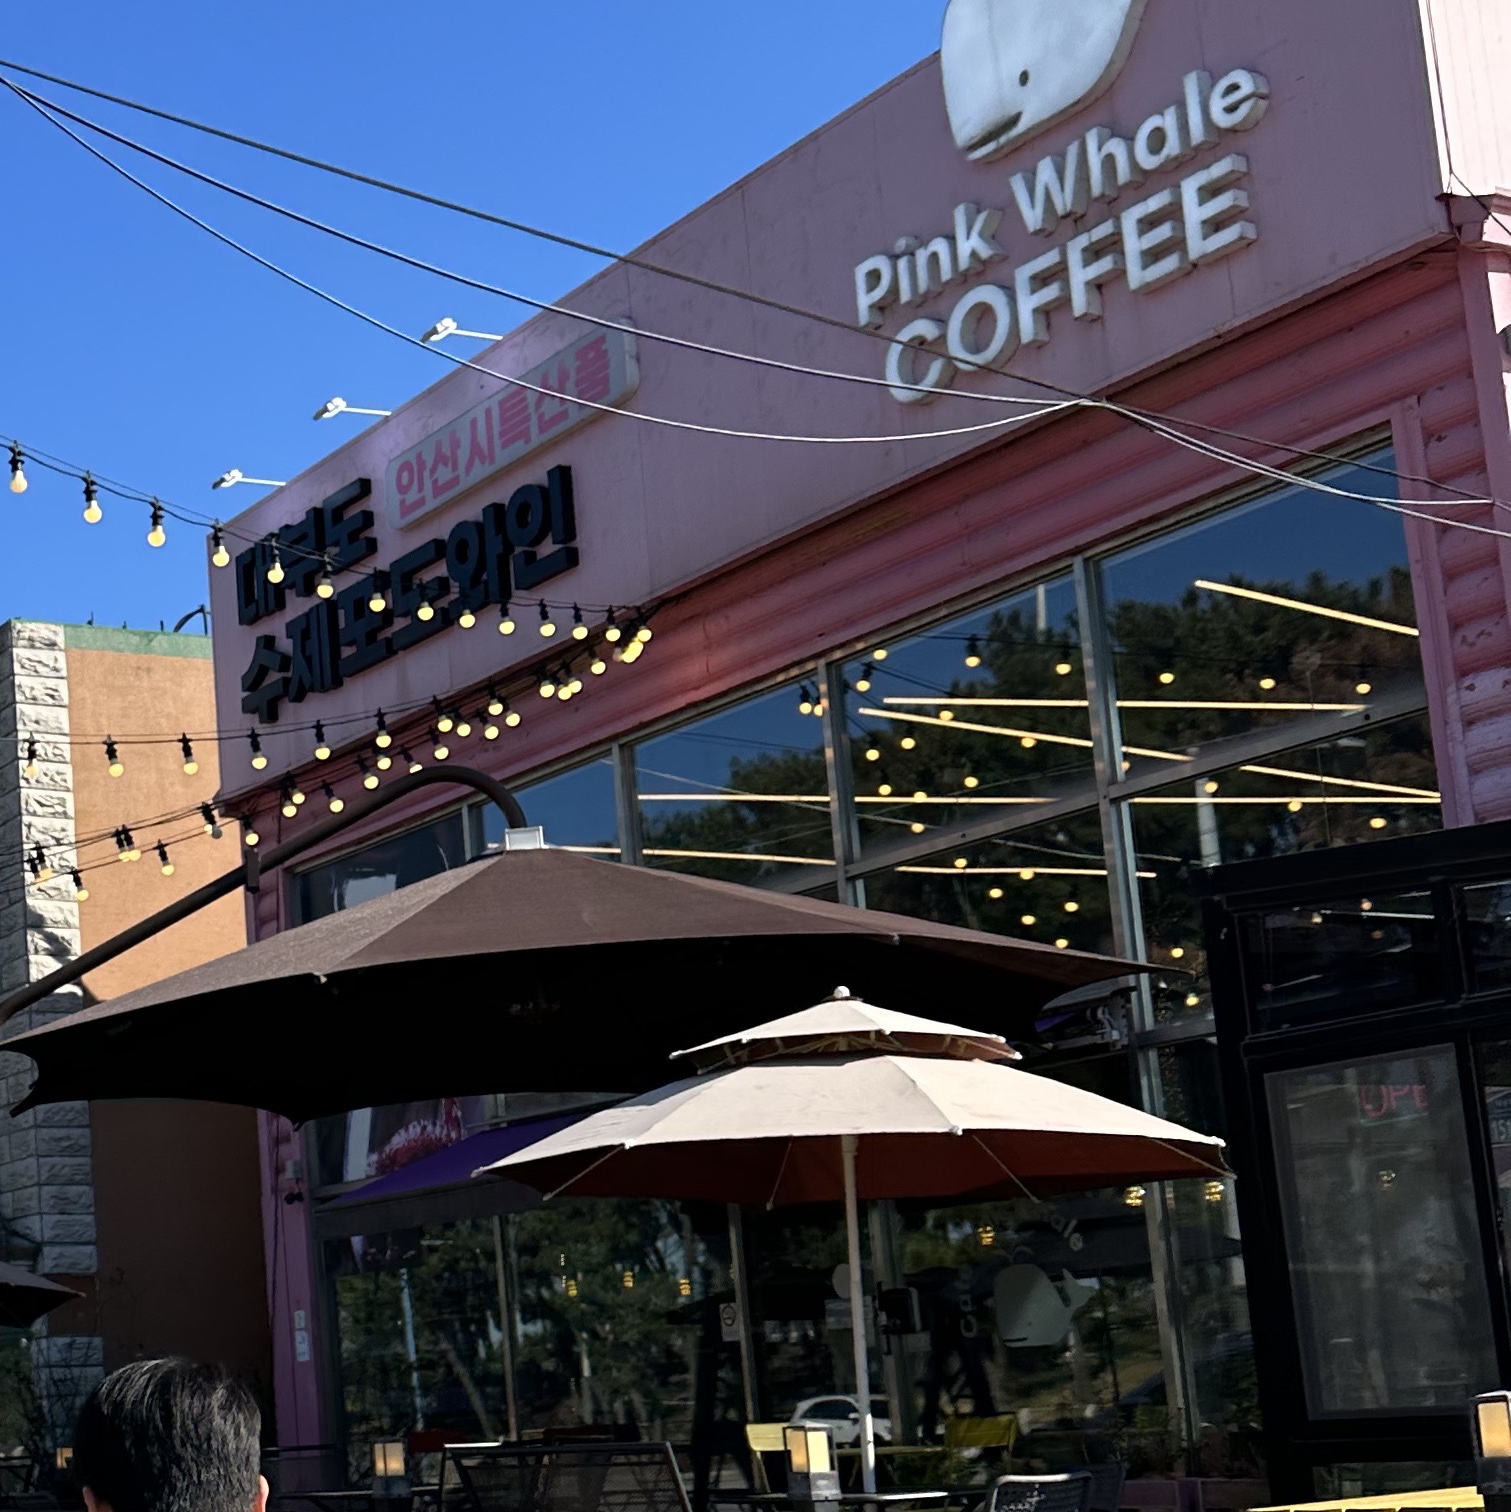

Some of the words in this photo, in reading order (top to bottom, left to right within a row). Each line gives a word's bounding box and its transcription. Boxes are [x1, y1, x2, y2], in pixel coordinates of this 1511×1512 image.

[854, 202, 1007, 329] Pink
[1010, 68, 1270, 237] Whale
[885, 153, 1258, 404] COFFEE
[394, 334, 612, 520] 안산시특산품
[235, 478, 378, 625] 대부도
